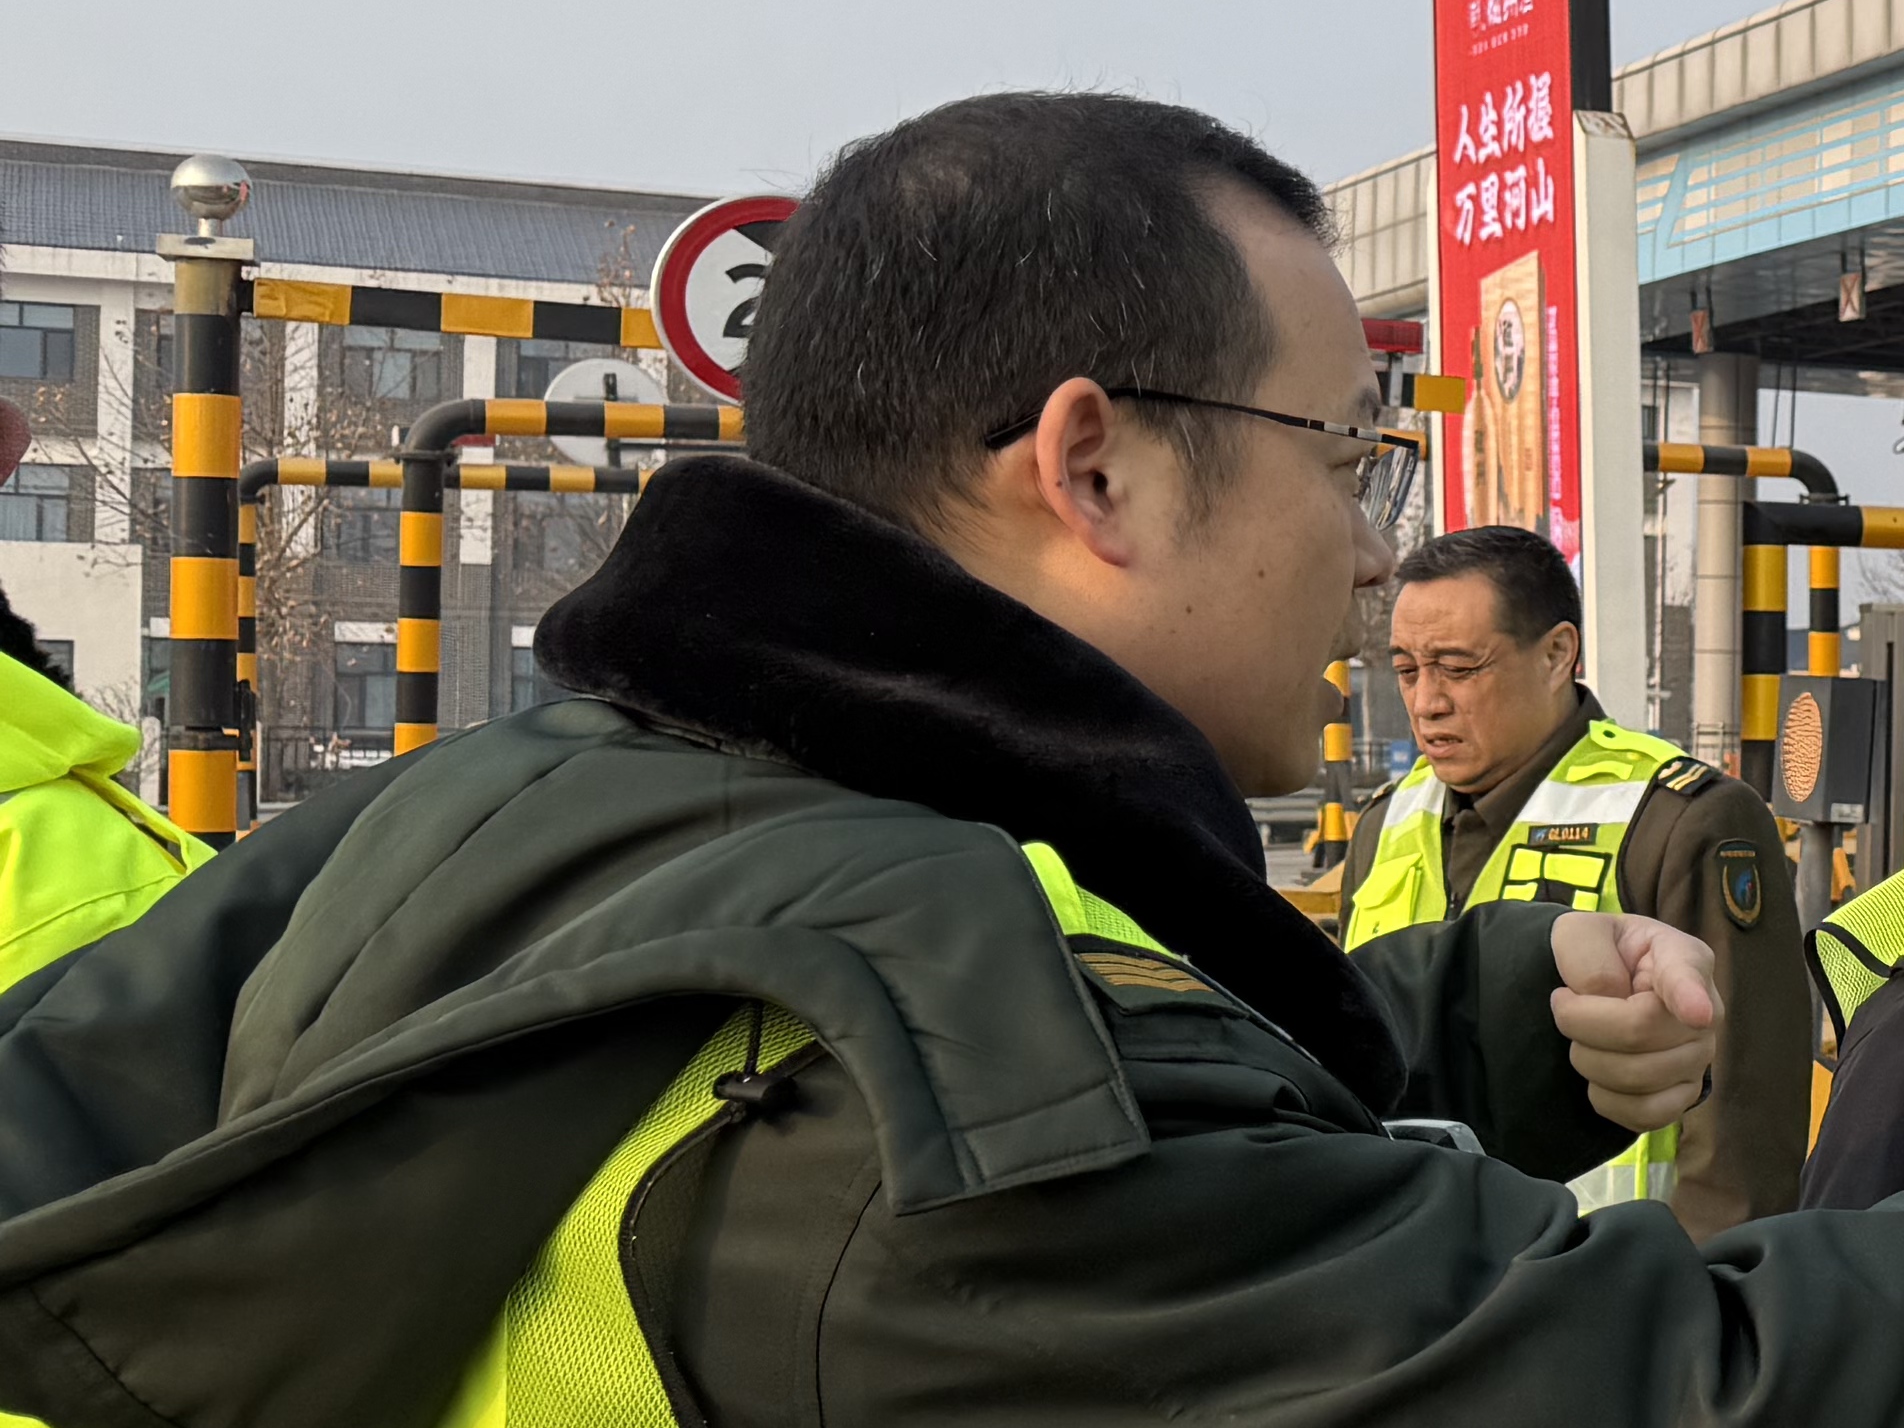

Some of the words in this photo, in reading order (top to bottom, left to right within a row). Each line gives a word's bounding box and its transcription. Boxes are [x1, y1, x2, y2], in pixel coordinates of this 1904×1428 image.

[1454, 72, 1554, 164] 人生所握
[1455, 157, 1555, 246] 万里河山
